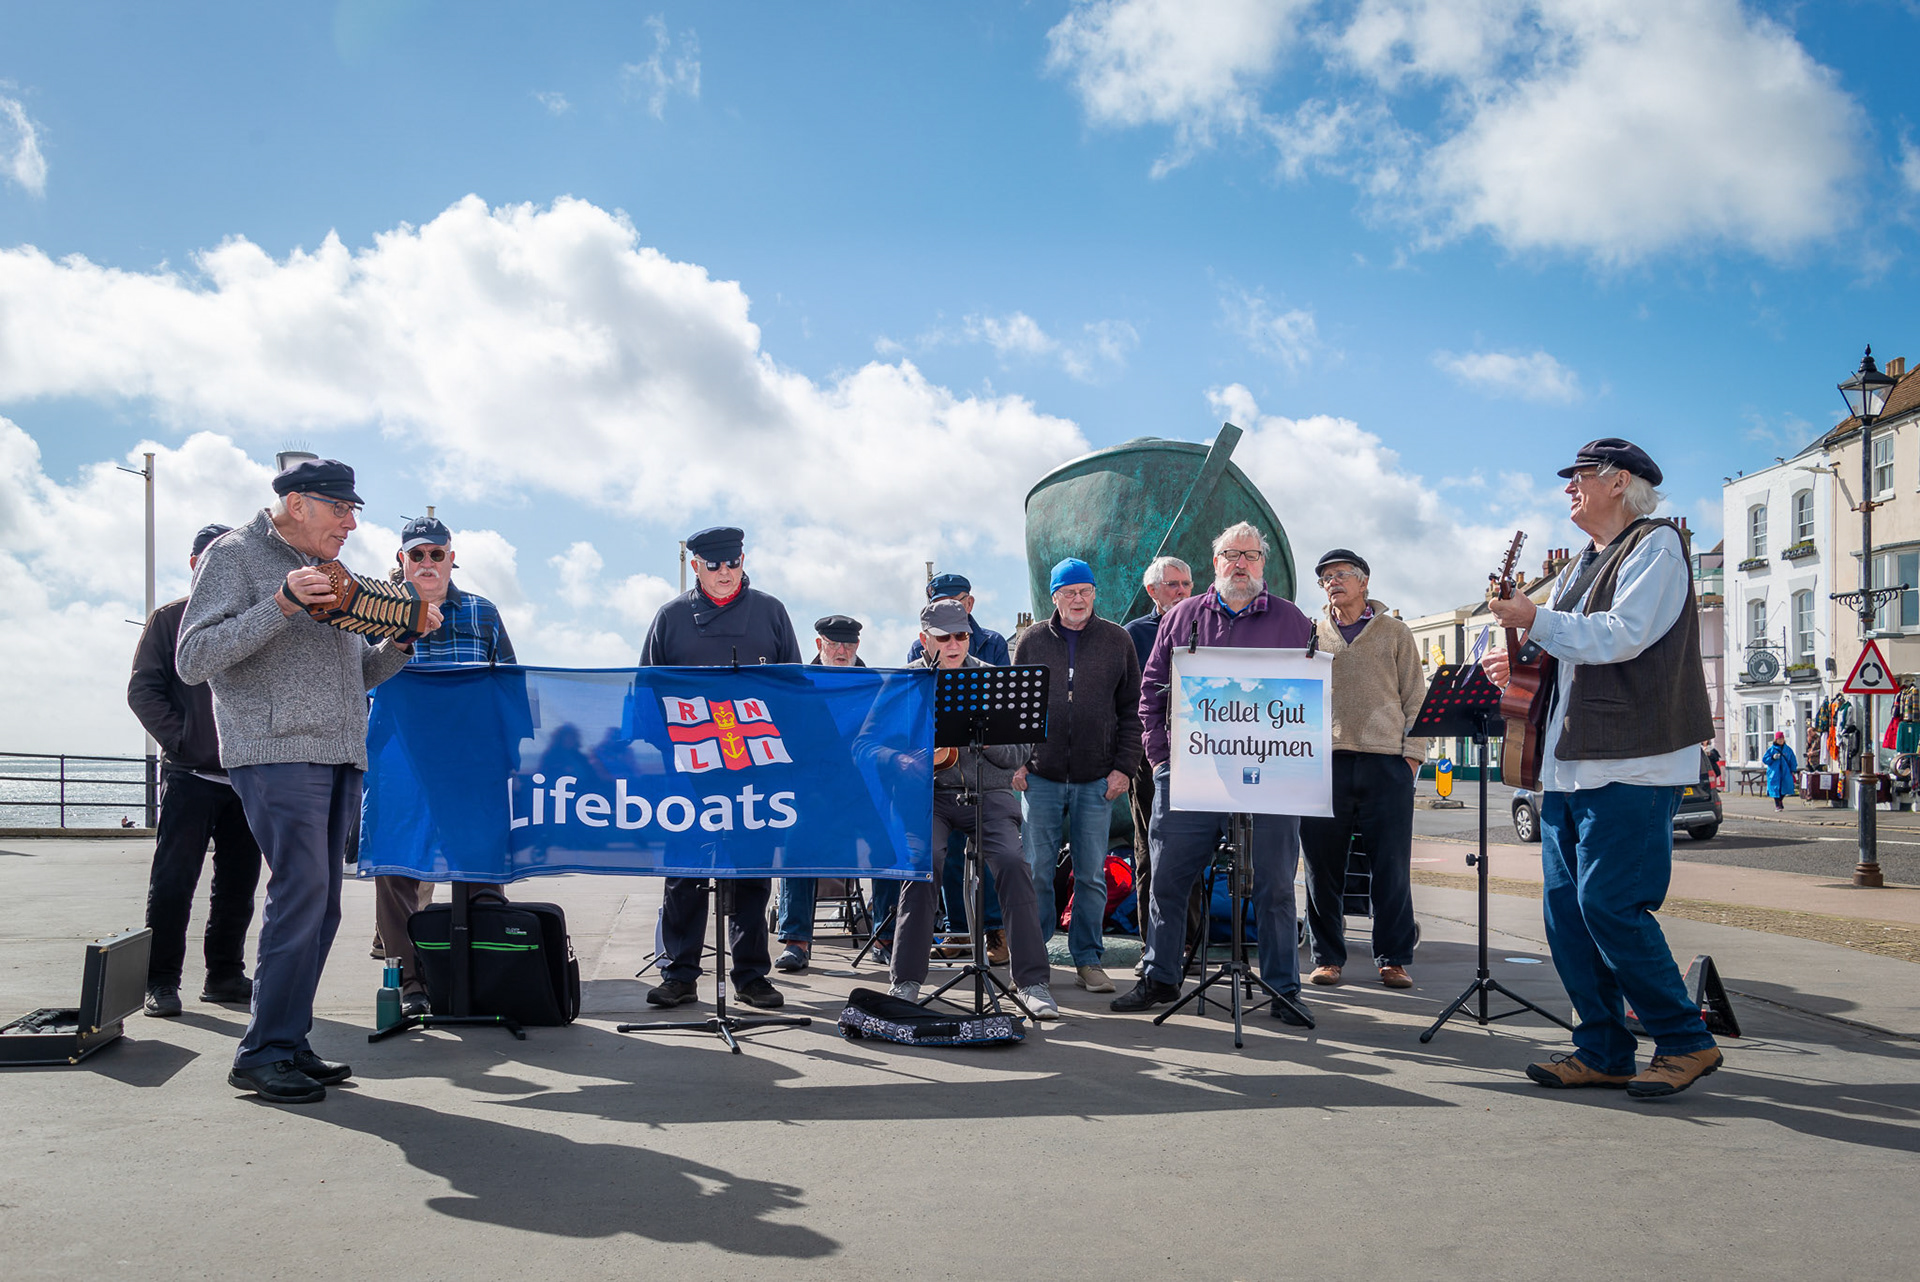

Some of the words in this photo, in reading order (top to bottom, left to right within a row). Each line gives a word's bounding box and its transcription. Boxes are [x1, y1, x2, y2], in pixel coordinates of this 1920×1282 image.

[677, 701, 699, 721] R
[743, 700, 763, 719] N
[1197, 698, 1260, 723] Kellet
[1267, 699, 1306, 730] Gut
[689, 748, 709, 770] L
[761, 740, 775, 760] I
[1188, 730, 1314, 764] Shantymen
[507, 773, 798, 832] Lifeboats
